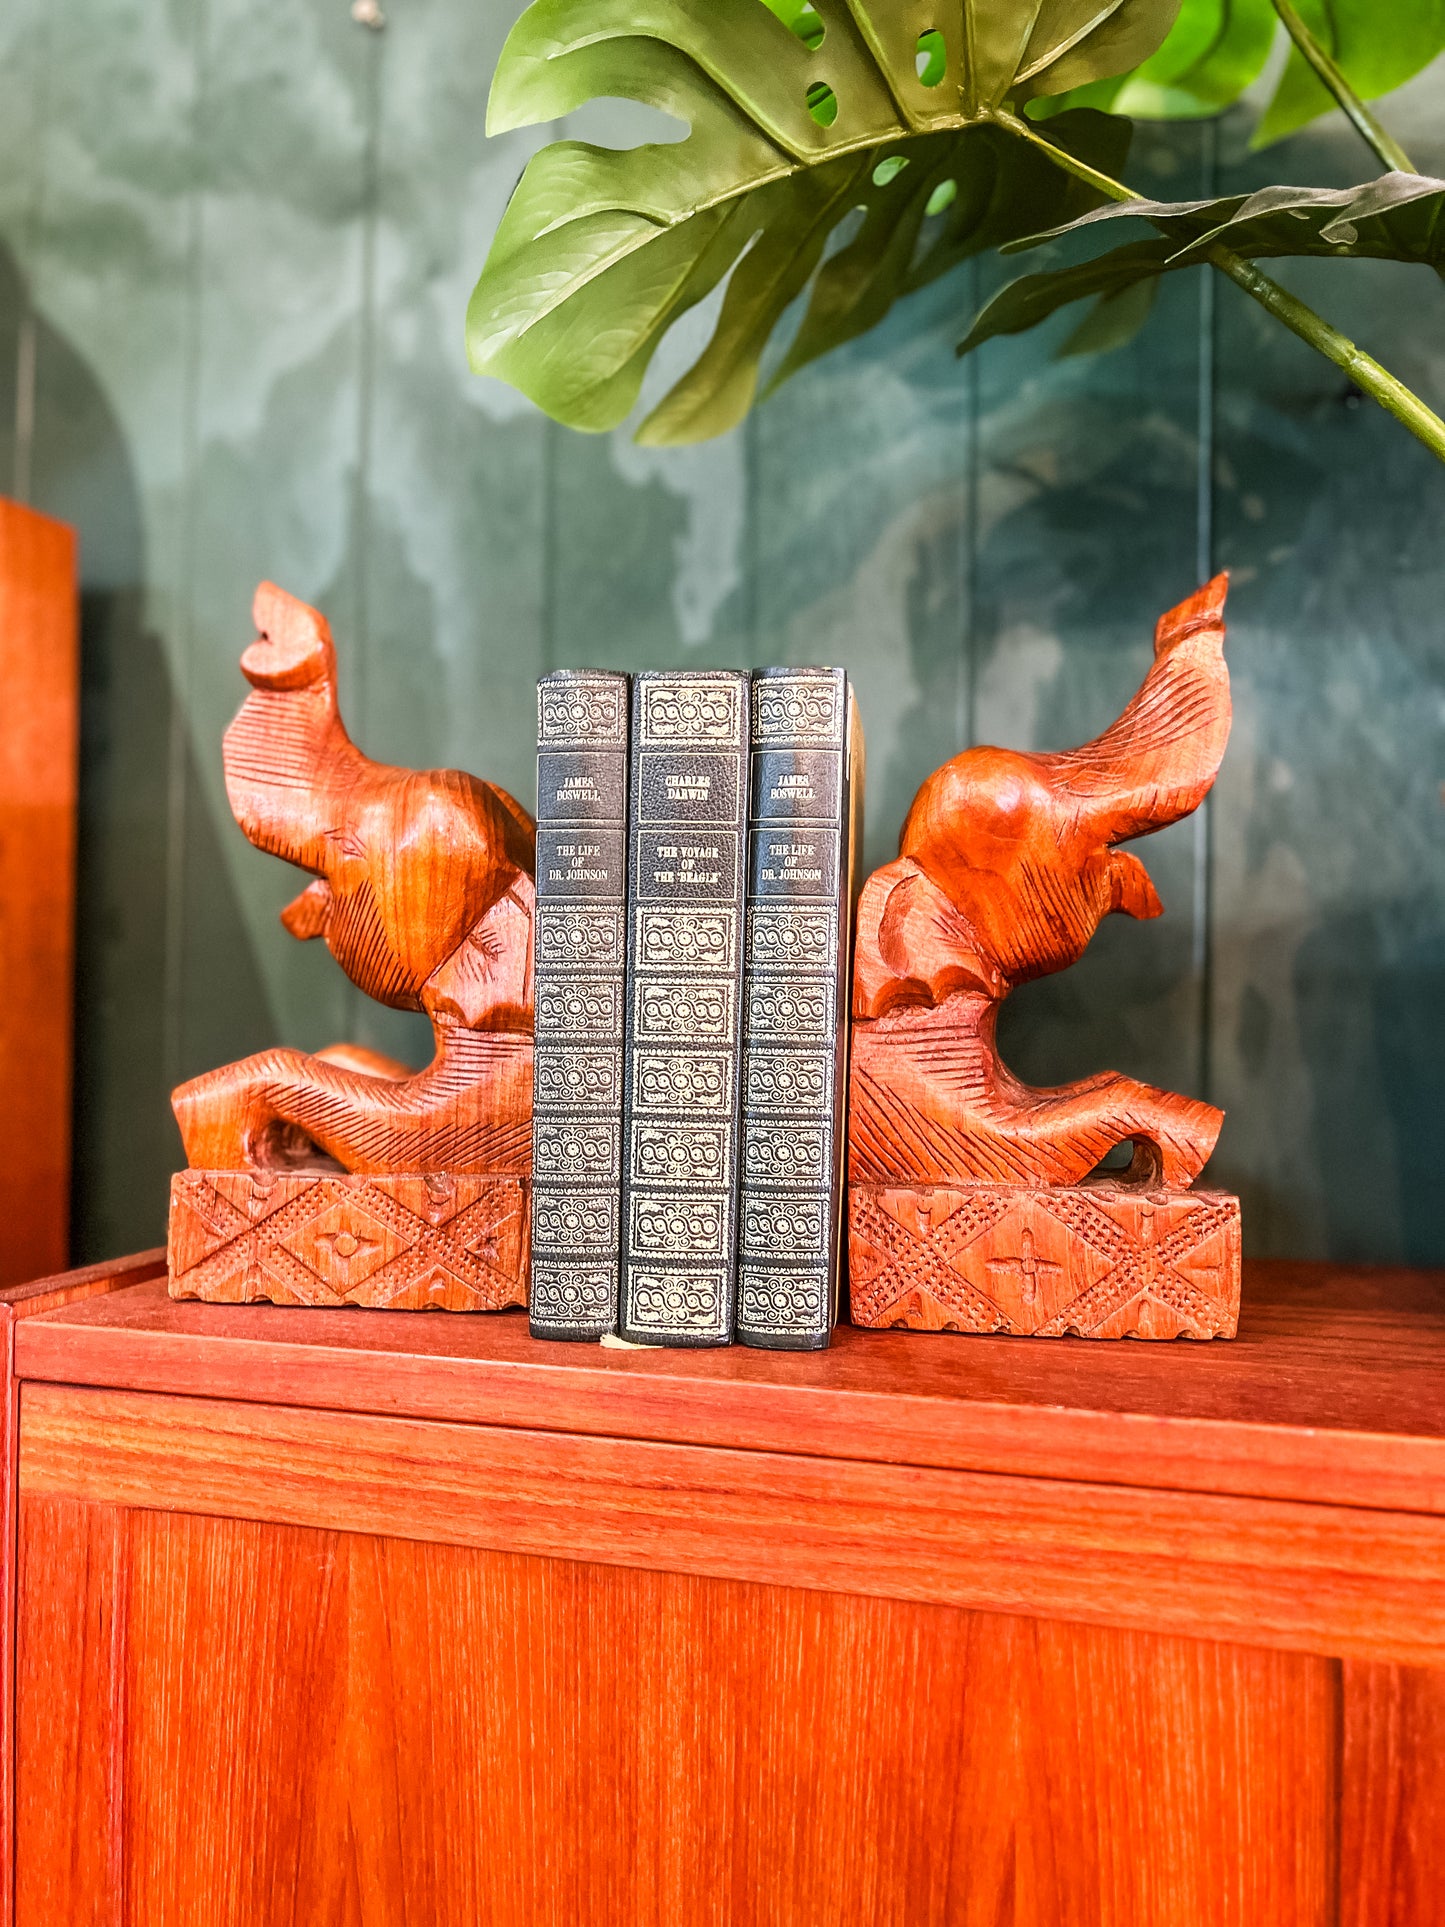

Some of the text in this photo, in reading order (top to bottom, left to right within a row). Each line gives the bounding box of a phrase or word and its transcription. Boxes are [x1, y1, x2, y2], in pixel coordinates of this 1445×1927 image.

[563, 777, 594, 788] JAMES
[665, 775, 711, 787] CHARLES
[777, 774, 809, 787] JAMES
[556, 789, 601, 801] BOSWELL
[667, 788, 709, 800] DARWIN
[770, 787, 816, 799] BOSWELL
[556, 845, 601, 856] THE LIFE
[657, 846, 719, 858] THE VOYAGE
[769, 844, 815, 856] THE LIFE
[571, 857, 585, 868] OF
[681, 859, 695, 870] OF
[784, 856, 798, 867] OF
[549, 869, 608, 880] DR. JOHNSON
[654, 871, 674, 883] THE
[761, 869, 822, 880] DR. JOHNSON
